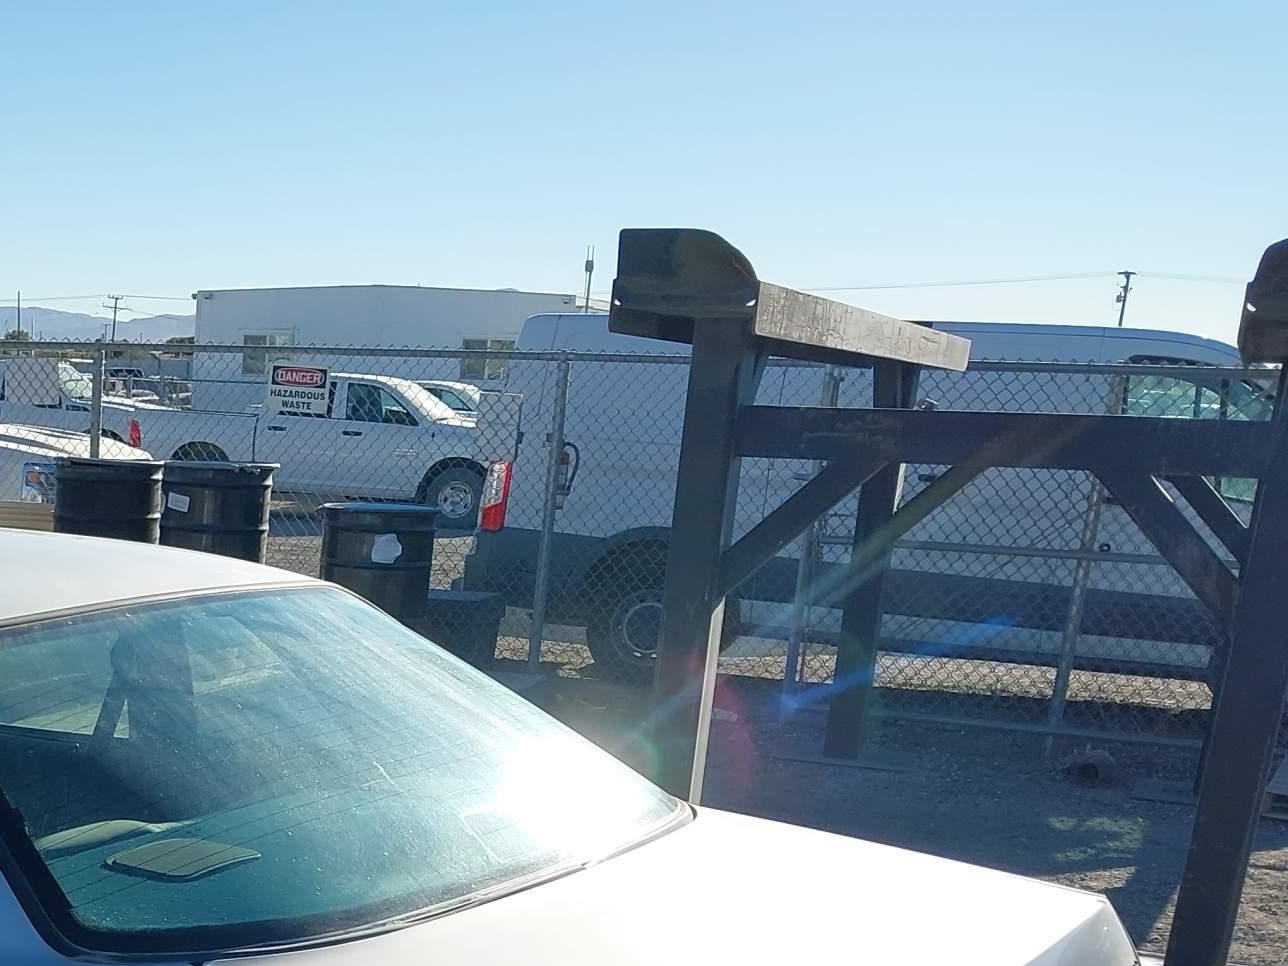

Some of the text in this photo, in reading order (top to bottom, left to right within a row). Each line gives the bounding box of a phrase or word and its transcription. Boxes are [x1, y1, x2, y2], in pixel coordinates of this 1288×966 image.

[278, 370, 322, 384] DANGER
[270, 388, 325, 401] HAZARDOUS
[281, 399, 312, 410] WASTE
